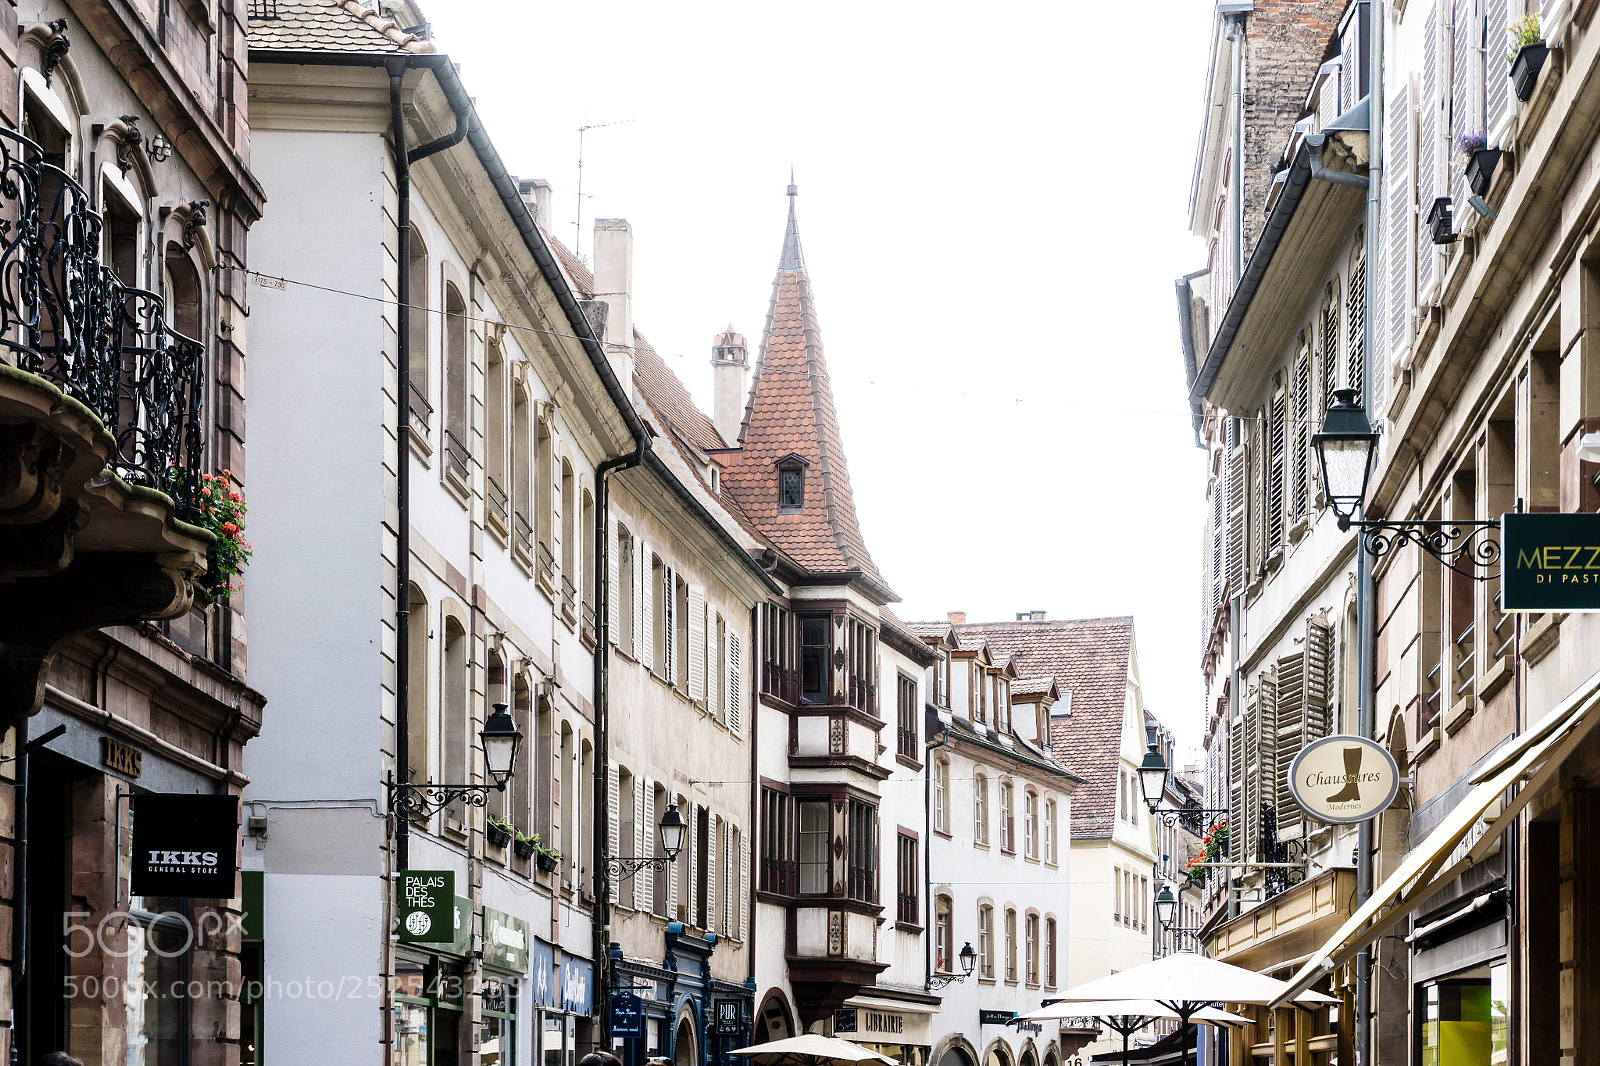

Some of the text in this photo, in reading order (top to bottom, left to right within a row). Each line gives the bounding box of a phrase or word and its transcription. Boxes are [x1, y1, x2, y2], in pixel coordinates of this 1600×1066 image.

[1516, 546, 1600, 569] MEZZ
[1536, 574, 1599, 584] DI PAST
[106, 738, 142, 779] IKKS
[1306, 771, 1381, 788] Chaussures
[1327, 803, 1362, 811] Modernes
[148, 850, 218, 866] IKKS
[405, 876, 445, 888] PALAIS
[405, 886, 428, 897] DES
[720, 1004, 736, 1020] PUR
[866, 1012, 903, 1034] LIBRAIRIE
